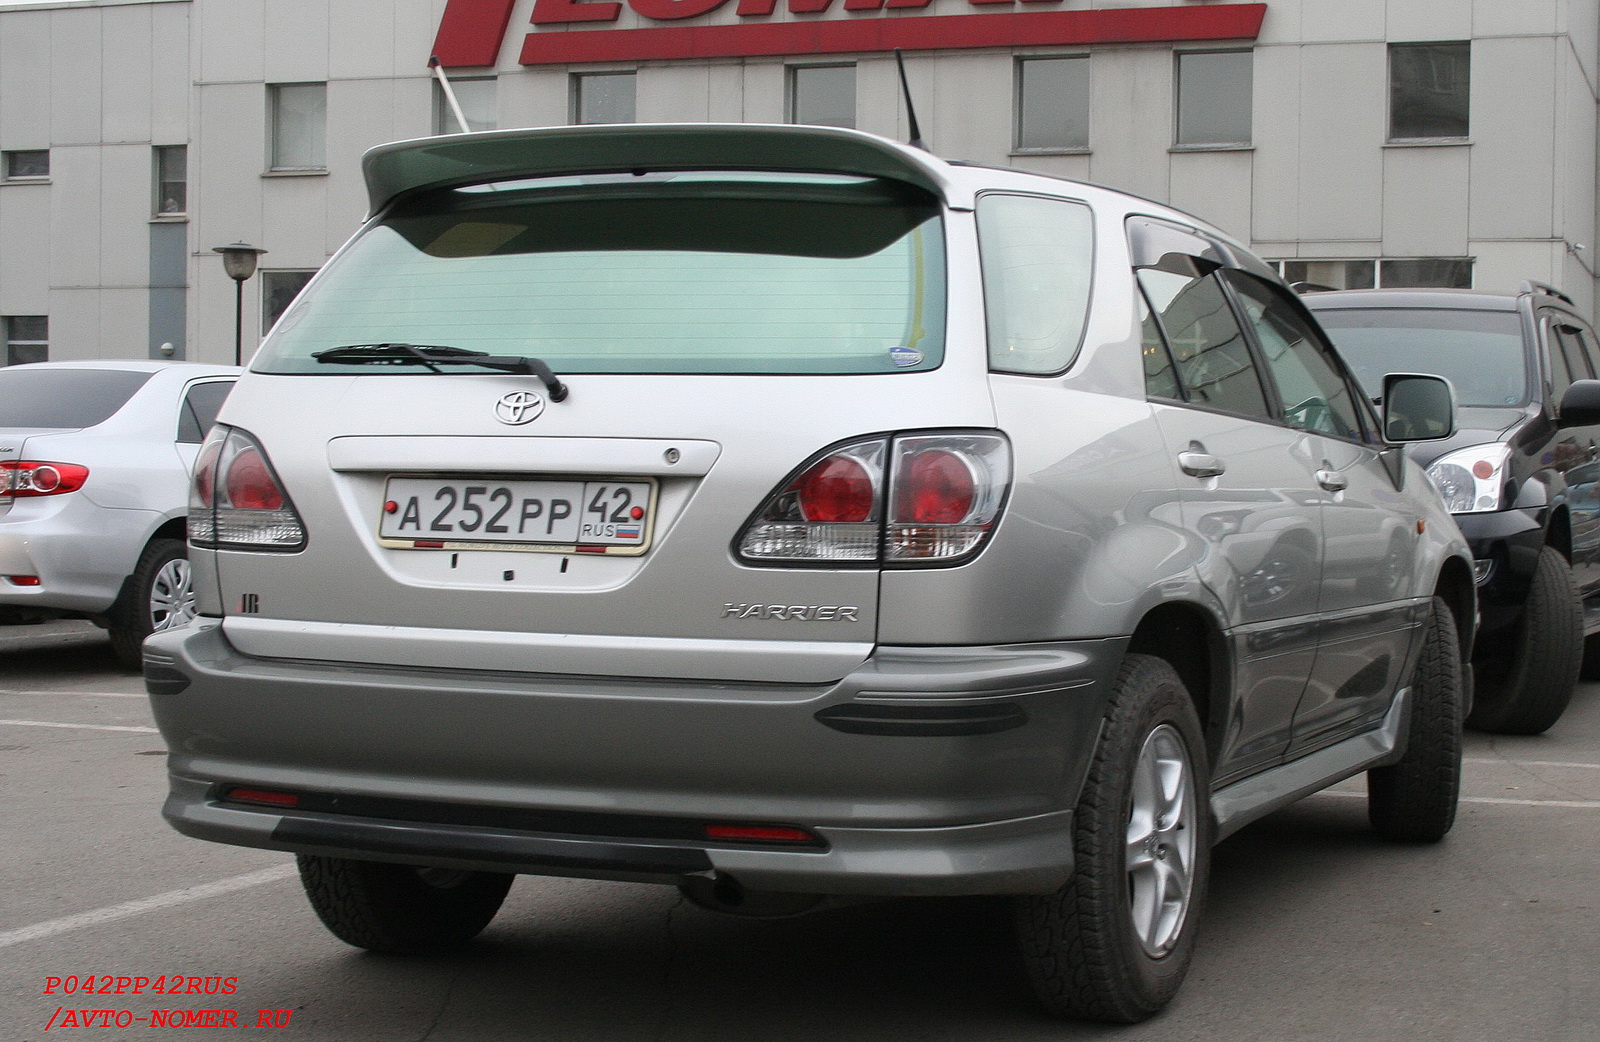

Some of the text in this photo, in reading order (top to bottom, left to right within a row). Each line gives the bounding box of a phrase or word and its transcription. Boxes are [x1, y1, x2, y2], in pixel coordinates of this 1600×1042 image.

[588, 487, 632, 523] 42
[581, 523, 614, 537] RUS
[720, 602, 859, 622] HARRIER
